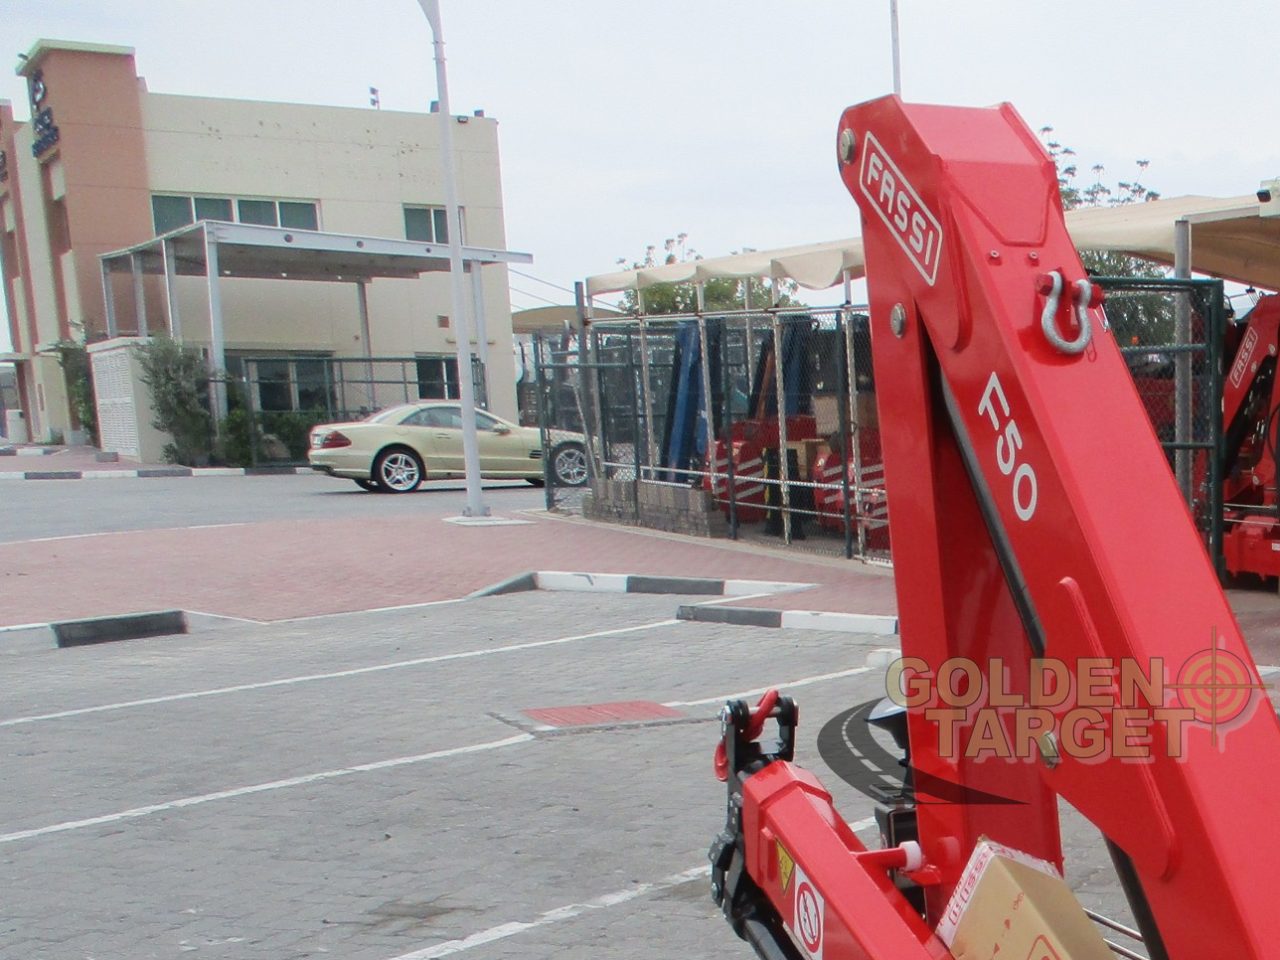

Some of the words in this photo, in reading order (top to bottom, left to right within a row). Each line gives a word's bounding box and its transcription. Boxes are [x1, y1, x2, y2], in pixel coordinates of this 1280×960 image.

[867, 152, 934, 265] FASSI
[1233, 332, 1255, 382] FASSI
[978, 371, 1038, 522] F50
